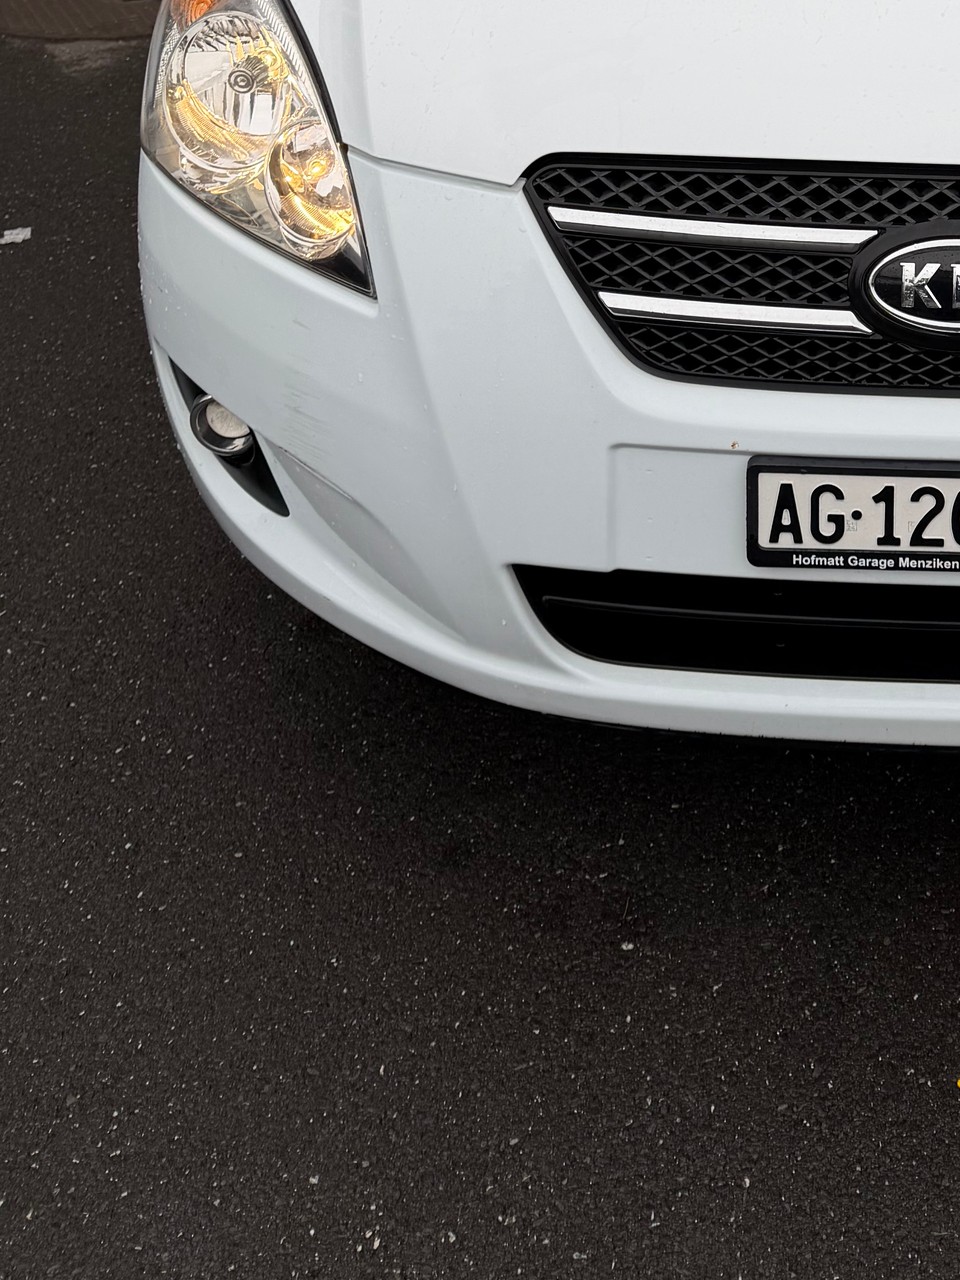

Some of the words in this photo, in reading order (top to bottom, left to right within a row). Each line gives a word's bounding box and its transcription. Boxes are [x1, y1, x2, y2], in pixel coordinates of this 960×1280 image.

[792, 554, 844, 566] Hofmatt
[847, 556, 895, 569] Garage
[898, 557, 960, 569] Menziken
